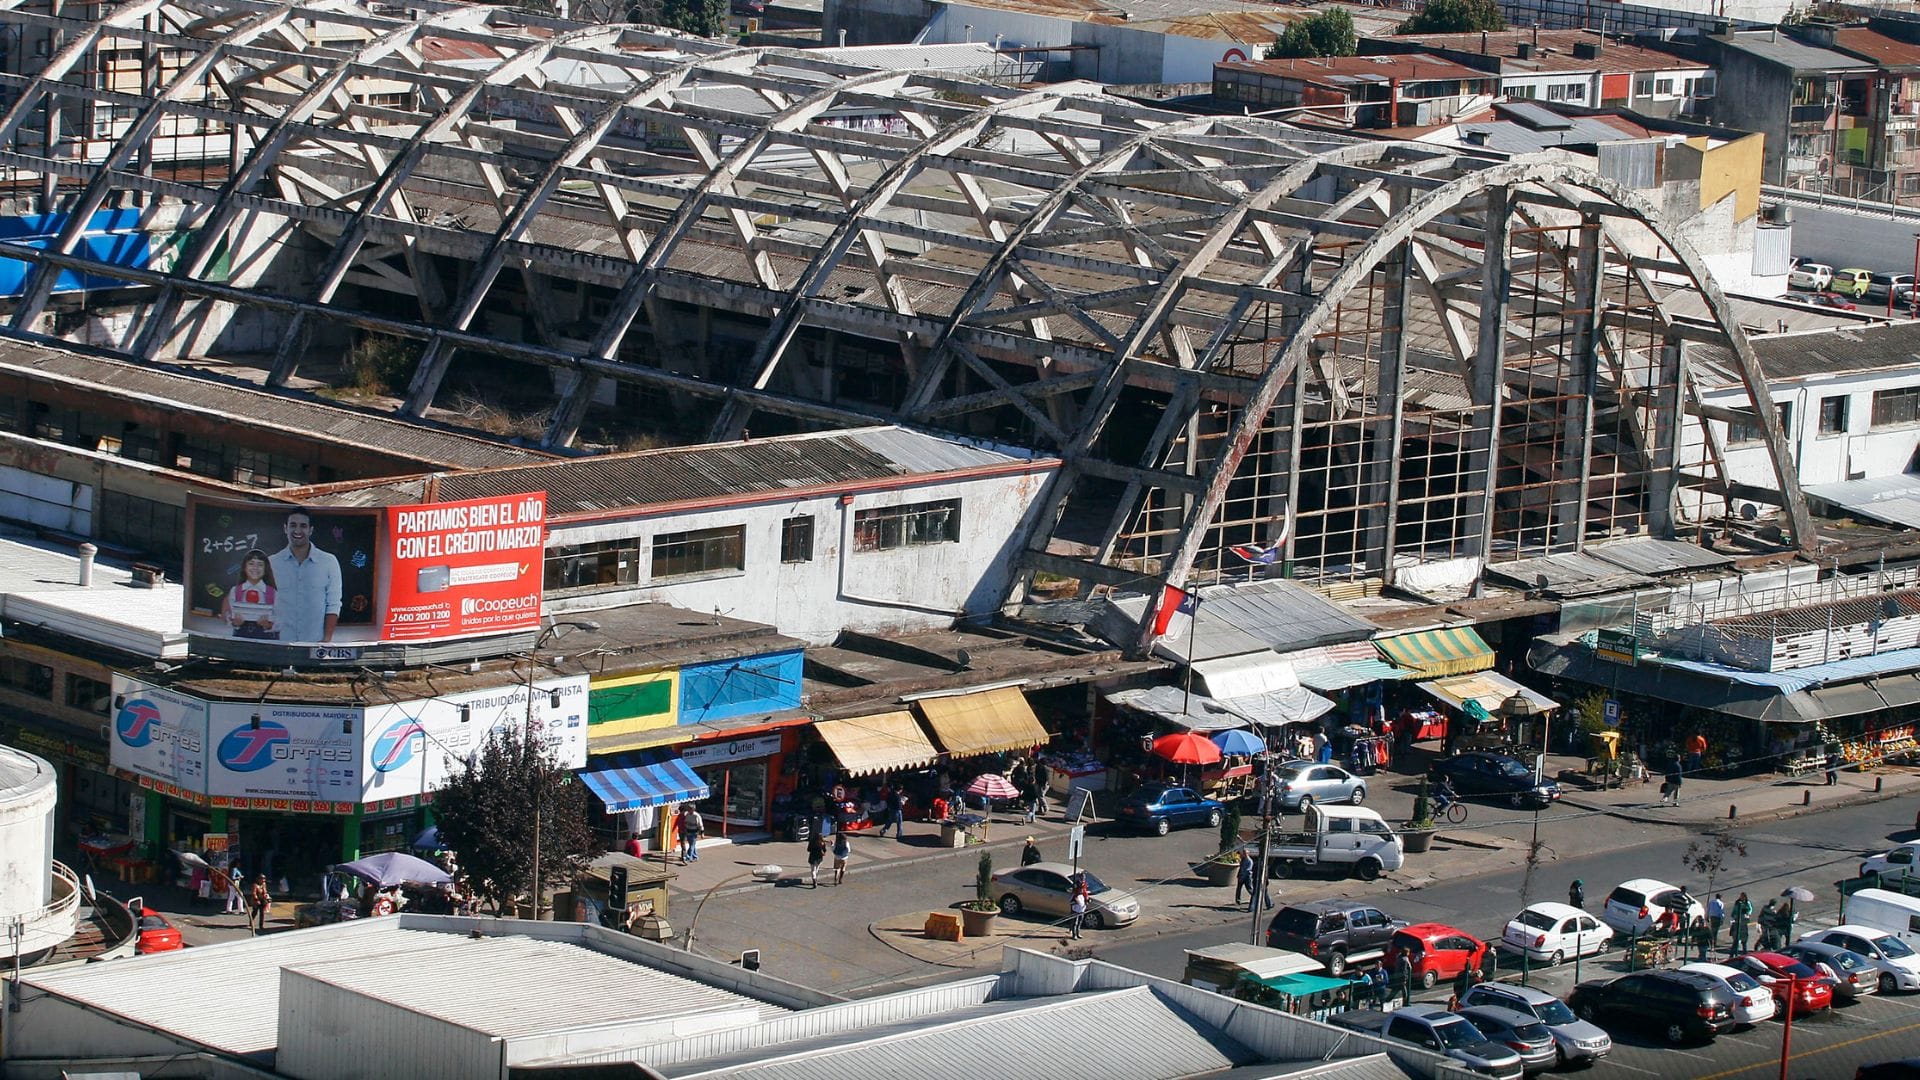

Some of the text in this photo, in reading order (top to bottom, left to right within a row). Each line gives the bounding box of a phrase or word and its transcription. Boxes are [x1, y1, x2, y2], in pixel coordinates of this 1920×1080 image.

[398, 497, 543, 533] PARTAMOS BIEN EL AÑO
[396, 526, 541, 559] CON EL CRÉDITO MARZO!
[475, 593, 537, 613] Coopeuch
[398, 610, 450, 622] 600 200 1200
[461, 615, 481, 625] Unidos
[483, 615, 494, 624] por
[502, 613, 514, 622] que
[515, 611, 537, 621] quieres
[328, 648, 352, 658] CBS
[1608, 705, 1615, 714] E
